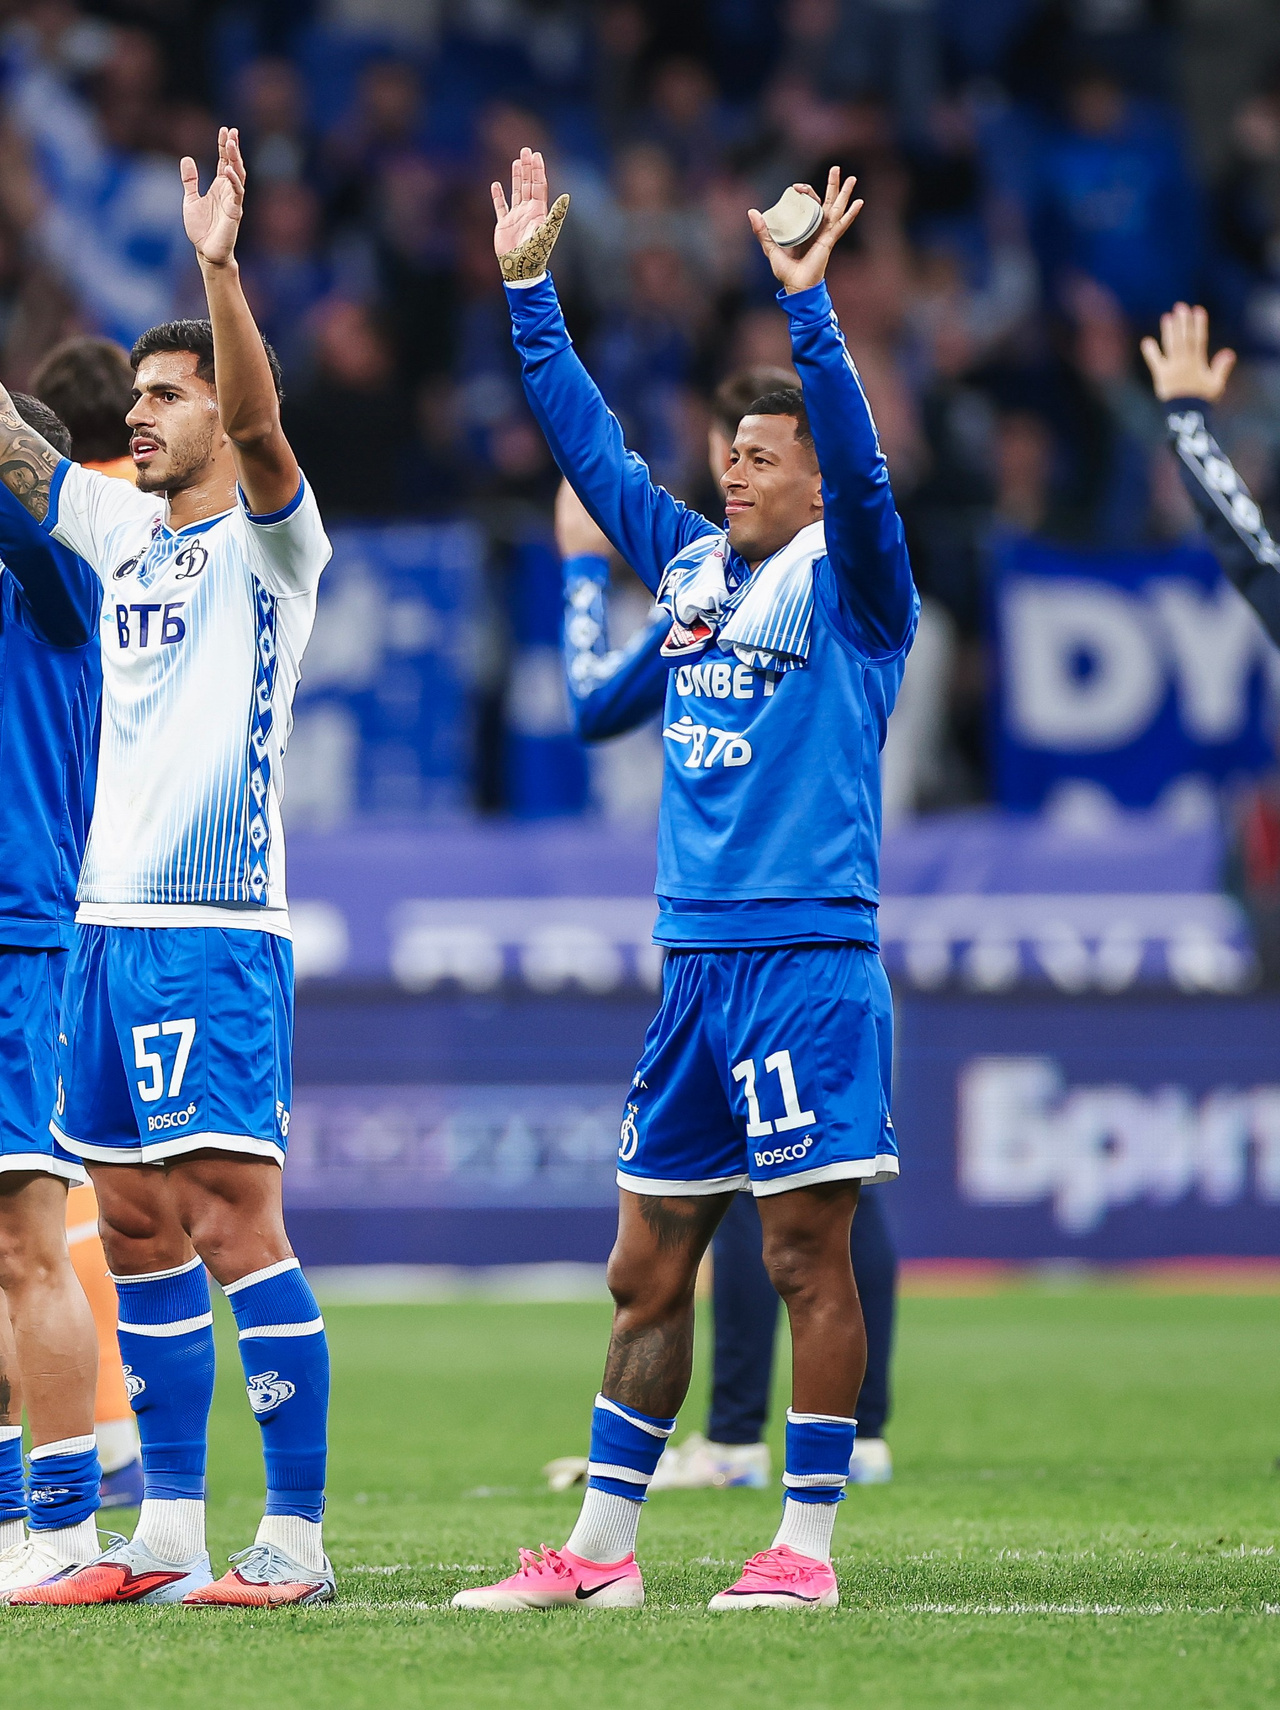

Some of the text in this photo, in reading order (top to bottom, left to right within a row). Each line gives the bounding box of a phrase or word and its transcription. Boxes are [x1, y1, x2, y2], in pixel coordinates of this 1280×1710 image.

[116, 602, 186, 649] ВТБ
[131, 1018, 196, 1102] 57
[731, 1049, 816, 1138] 11
[148, 1110, 189, 1132] BOSCO
[753, 1144, 807, 1168] BOSCO
